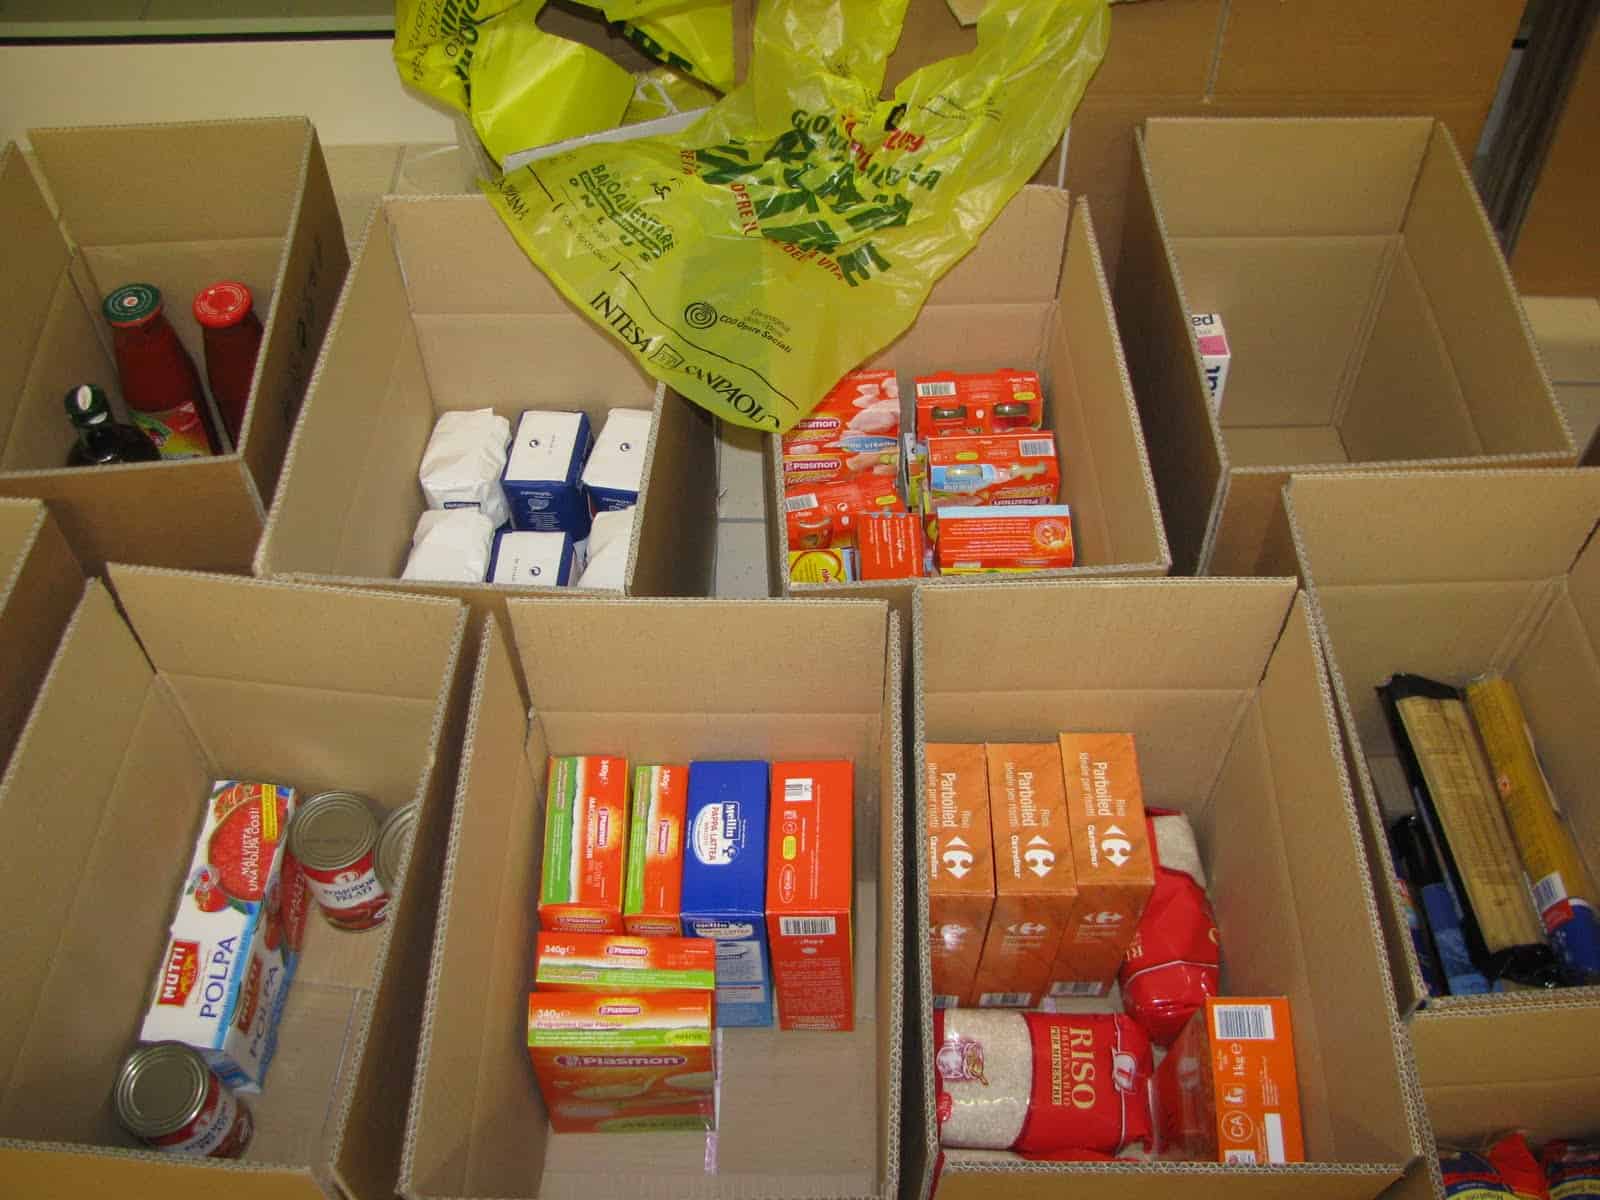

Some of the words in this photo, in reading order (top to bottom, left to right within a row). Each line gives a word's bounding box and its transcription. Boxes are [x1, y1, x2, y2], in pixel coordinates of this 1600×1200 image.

[591, 291, 652, 353] INTESA
[941, 772, 957, 828] Parboiled
[1017, 771, 1036, 827] Parboiled
[1093, 761, 1112, 817] Parboiled
[724, 803, 737, 838] Mellin
[163, 946, 186, 999] MUTTI
[199, 936, 238, 1018] POLPA
[583, 1055, 679, 1065] Plasmon
[1069, 1027, 1096, 1109] RISO
